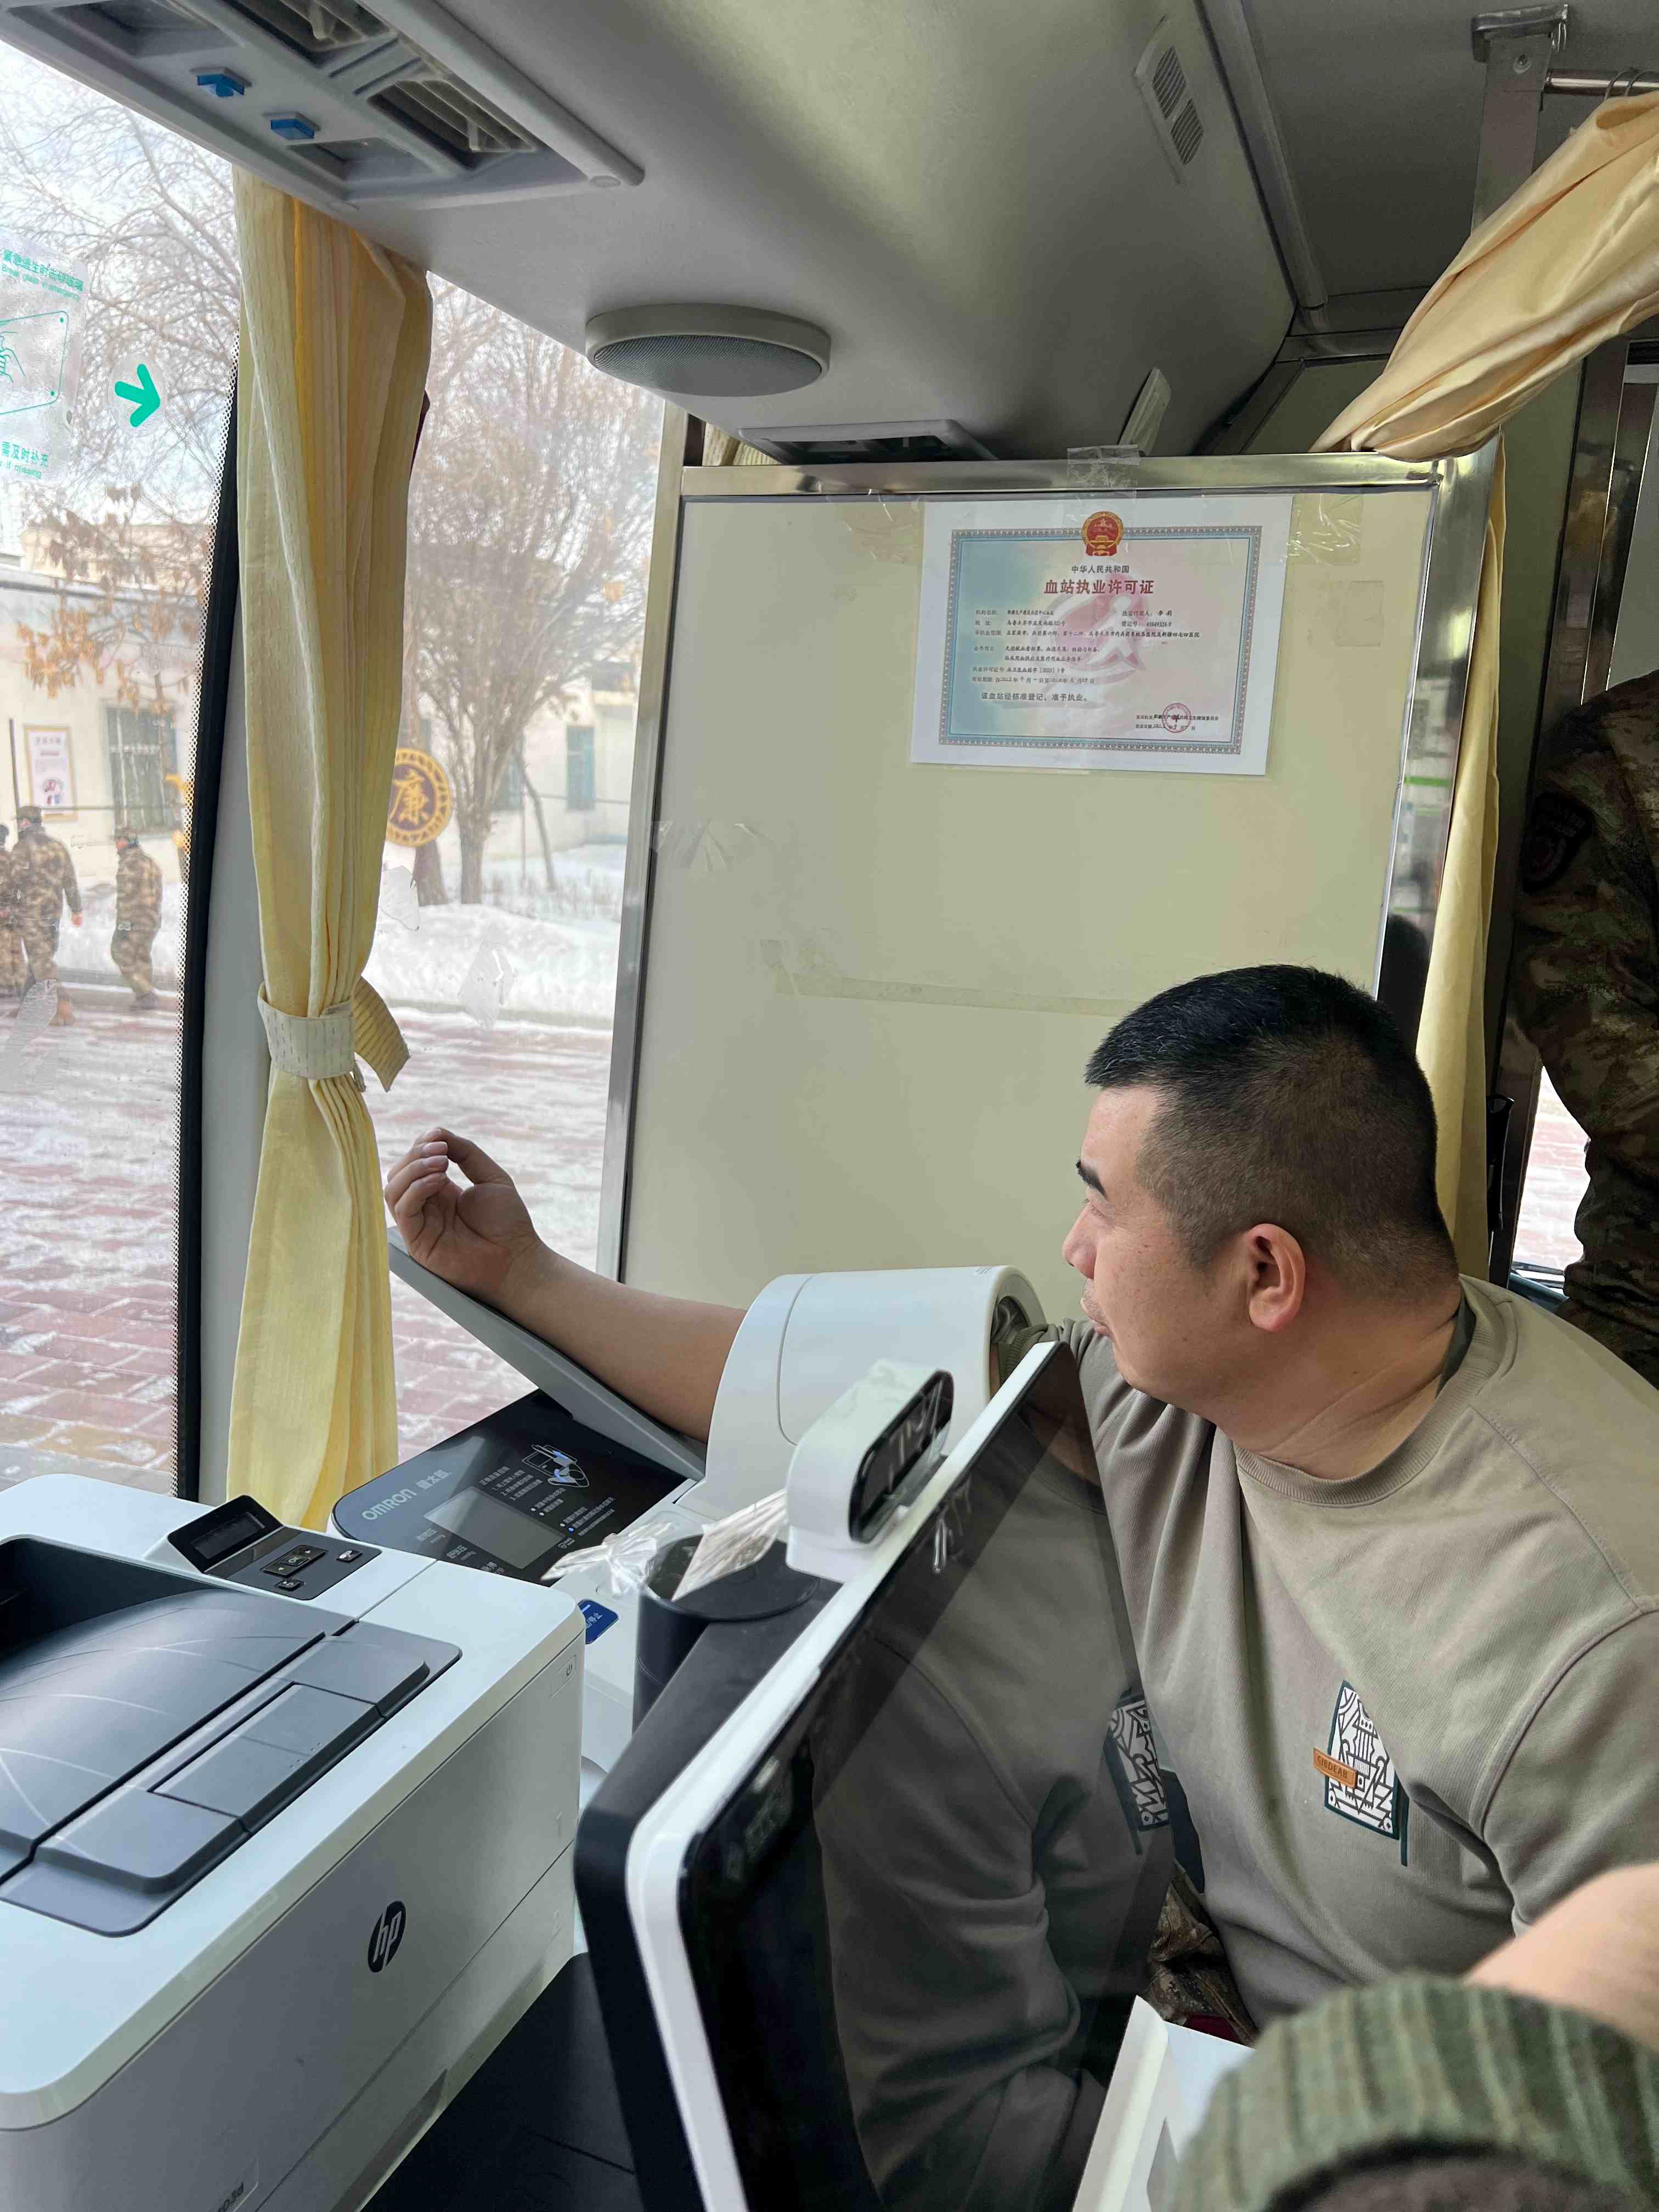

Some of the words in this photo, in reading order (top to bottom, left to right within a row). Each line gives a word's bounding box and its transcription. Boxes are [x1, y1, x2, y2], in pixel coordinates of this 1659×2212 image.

[1071, 565, 1130, 573] 中华人民共和国
[1044, 579, 1154, 594] 血站执业许可证
[370, 1905, 404, 1970] hp
